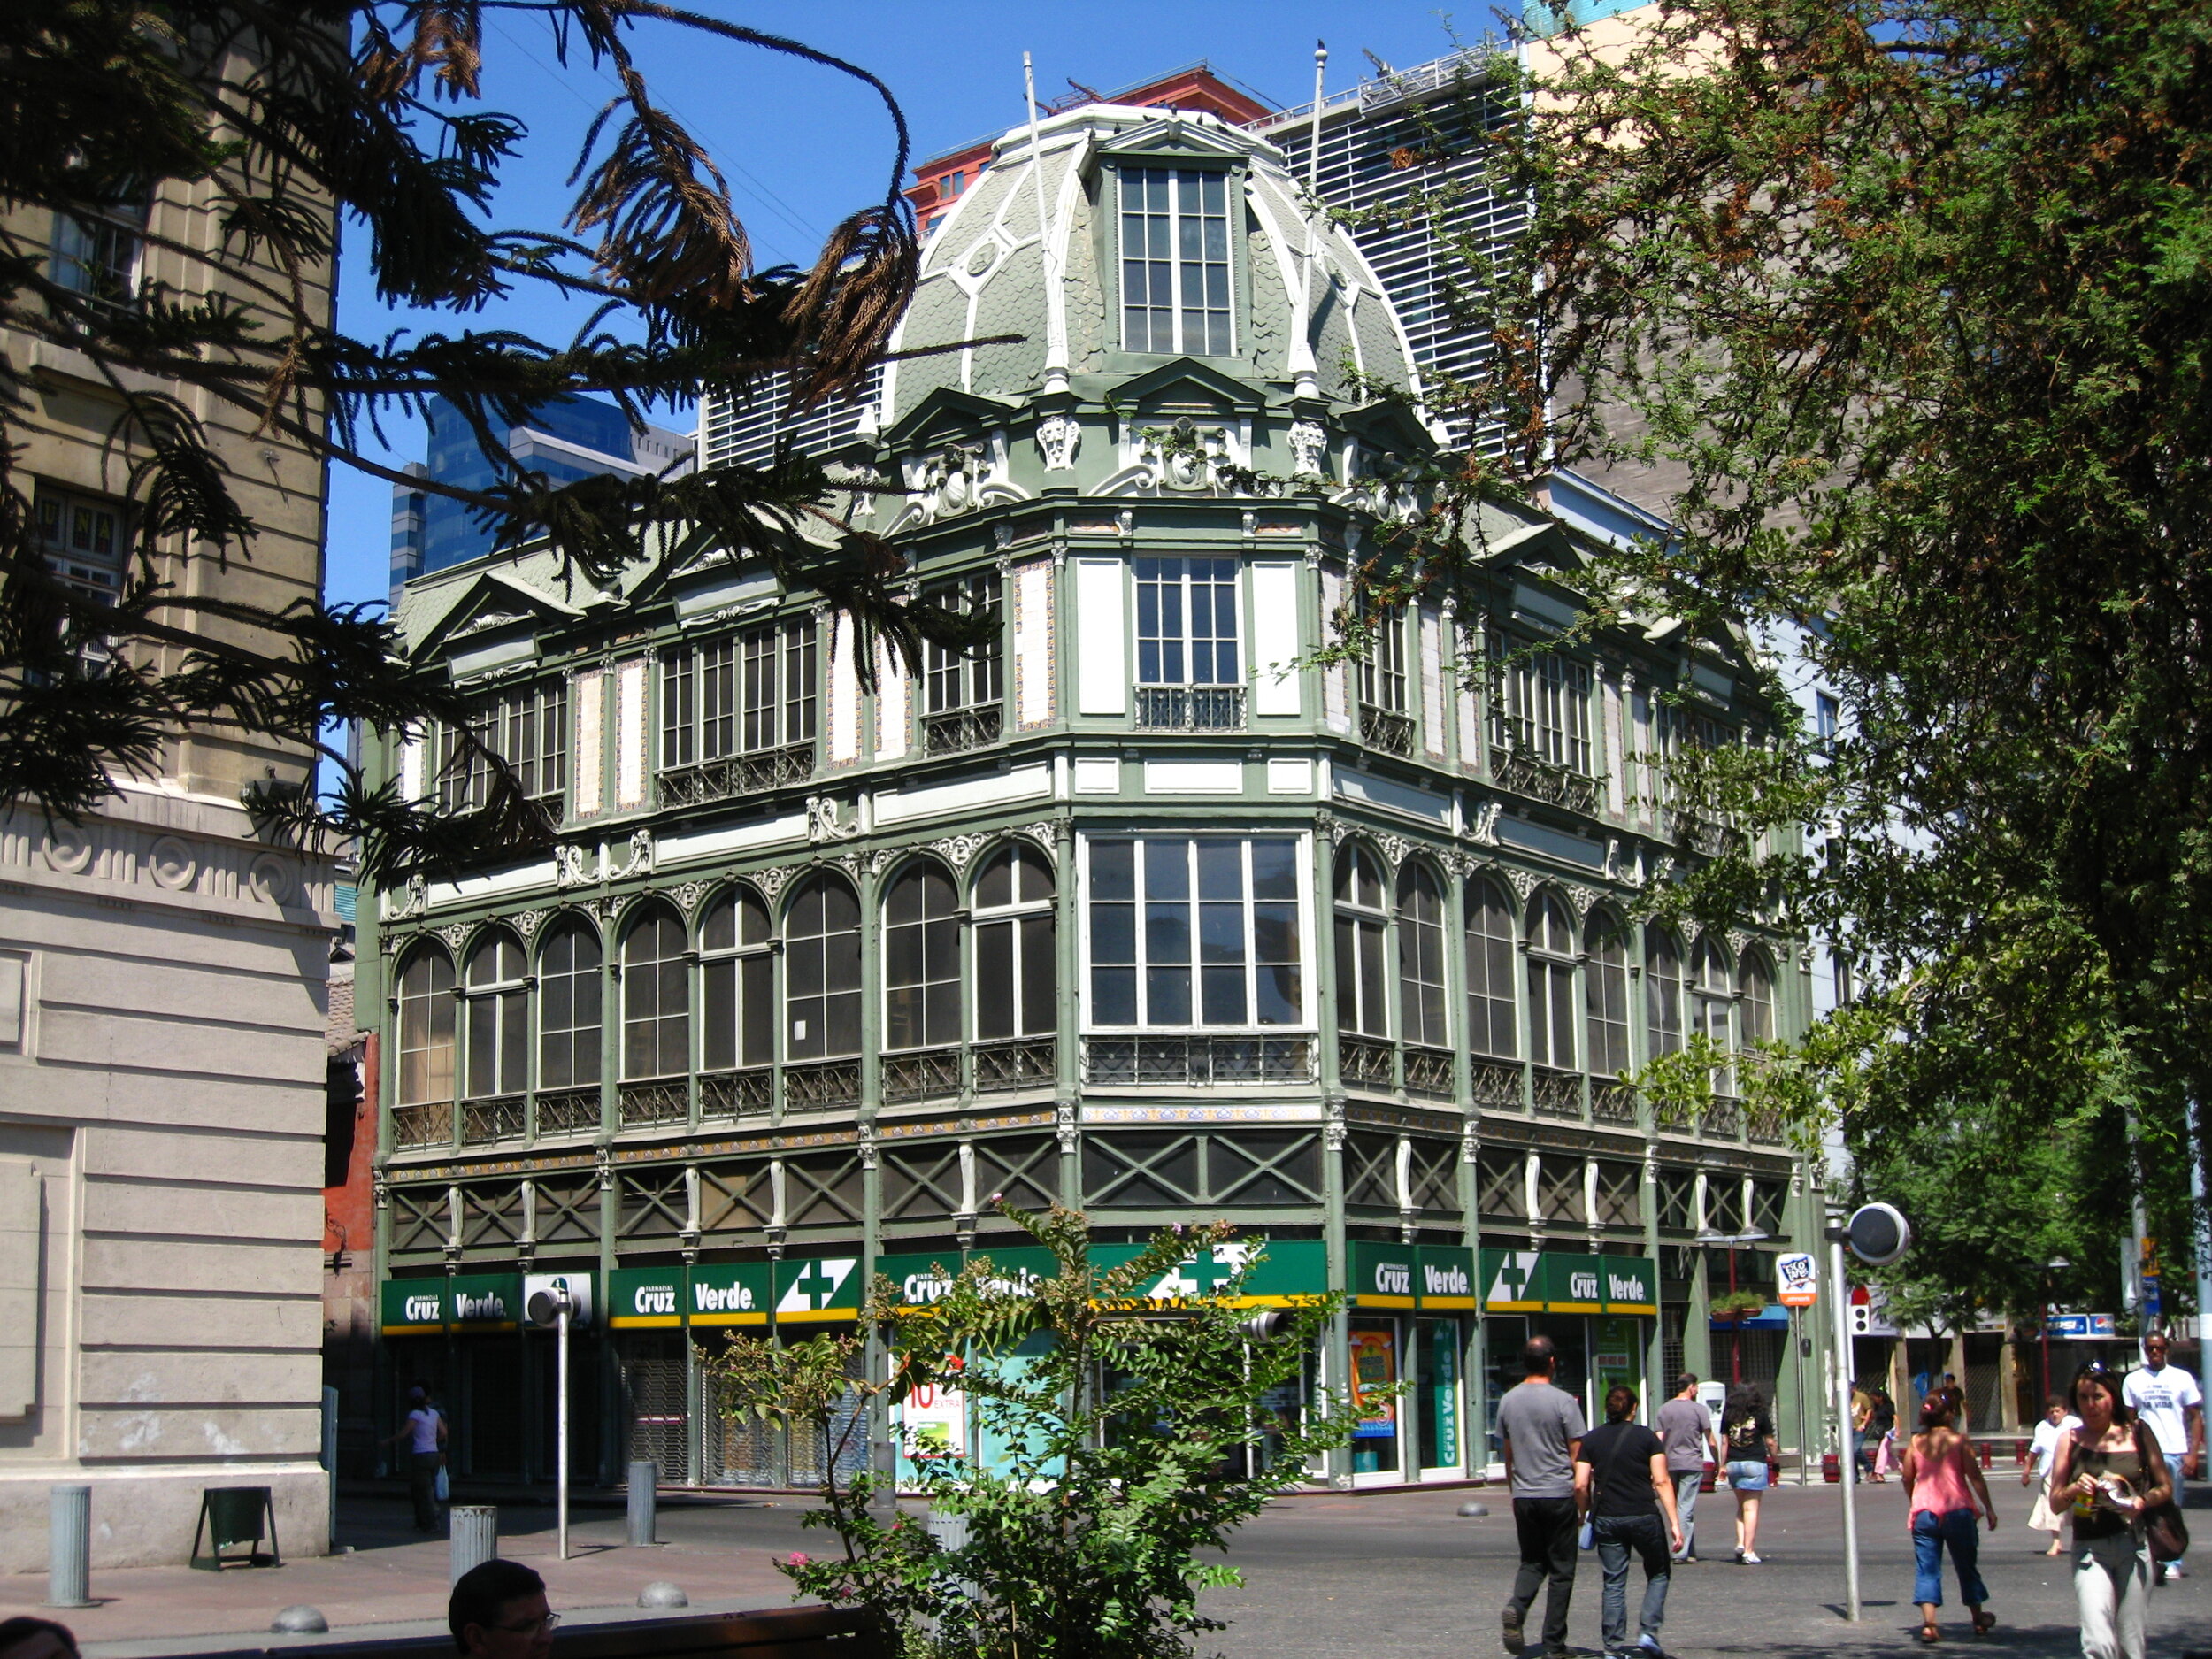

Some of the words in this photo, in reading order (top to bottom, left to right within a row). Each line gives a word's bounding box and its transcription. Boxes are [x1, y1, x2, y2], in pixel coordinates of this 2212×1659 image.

[1375, 1263, 1409, 1293] Cruz
[1424, 1265, 1468, 1294] Verde
[1571, 1272, 1598, 1299] Cruz
[1609, 1274, 1644, 1301] Verde
[405, 1296, 440, 1320] Cruz
[456, 1292, 504, 1318] Verde
[634, 1286, 675, 1313] Cruz
[695, 1281, 753, 1310] Verde
[2046, 1320, 2077, 1330] EPSI
[933, 1399, 960, 1409] EXTRA
[1444, 1415, 1455, 1463] Cruz
